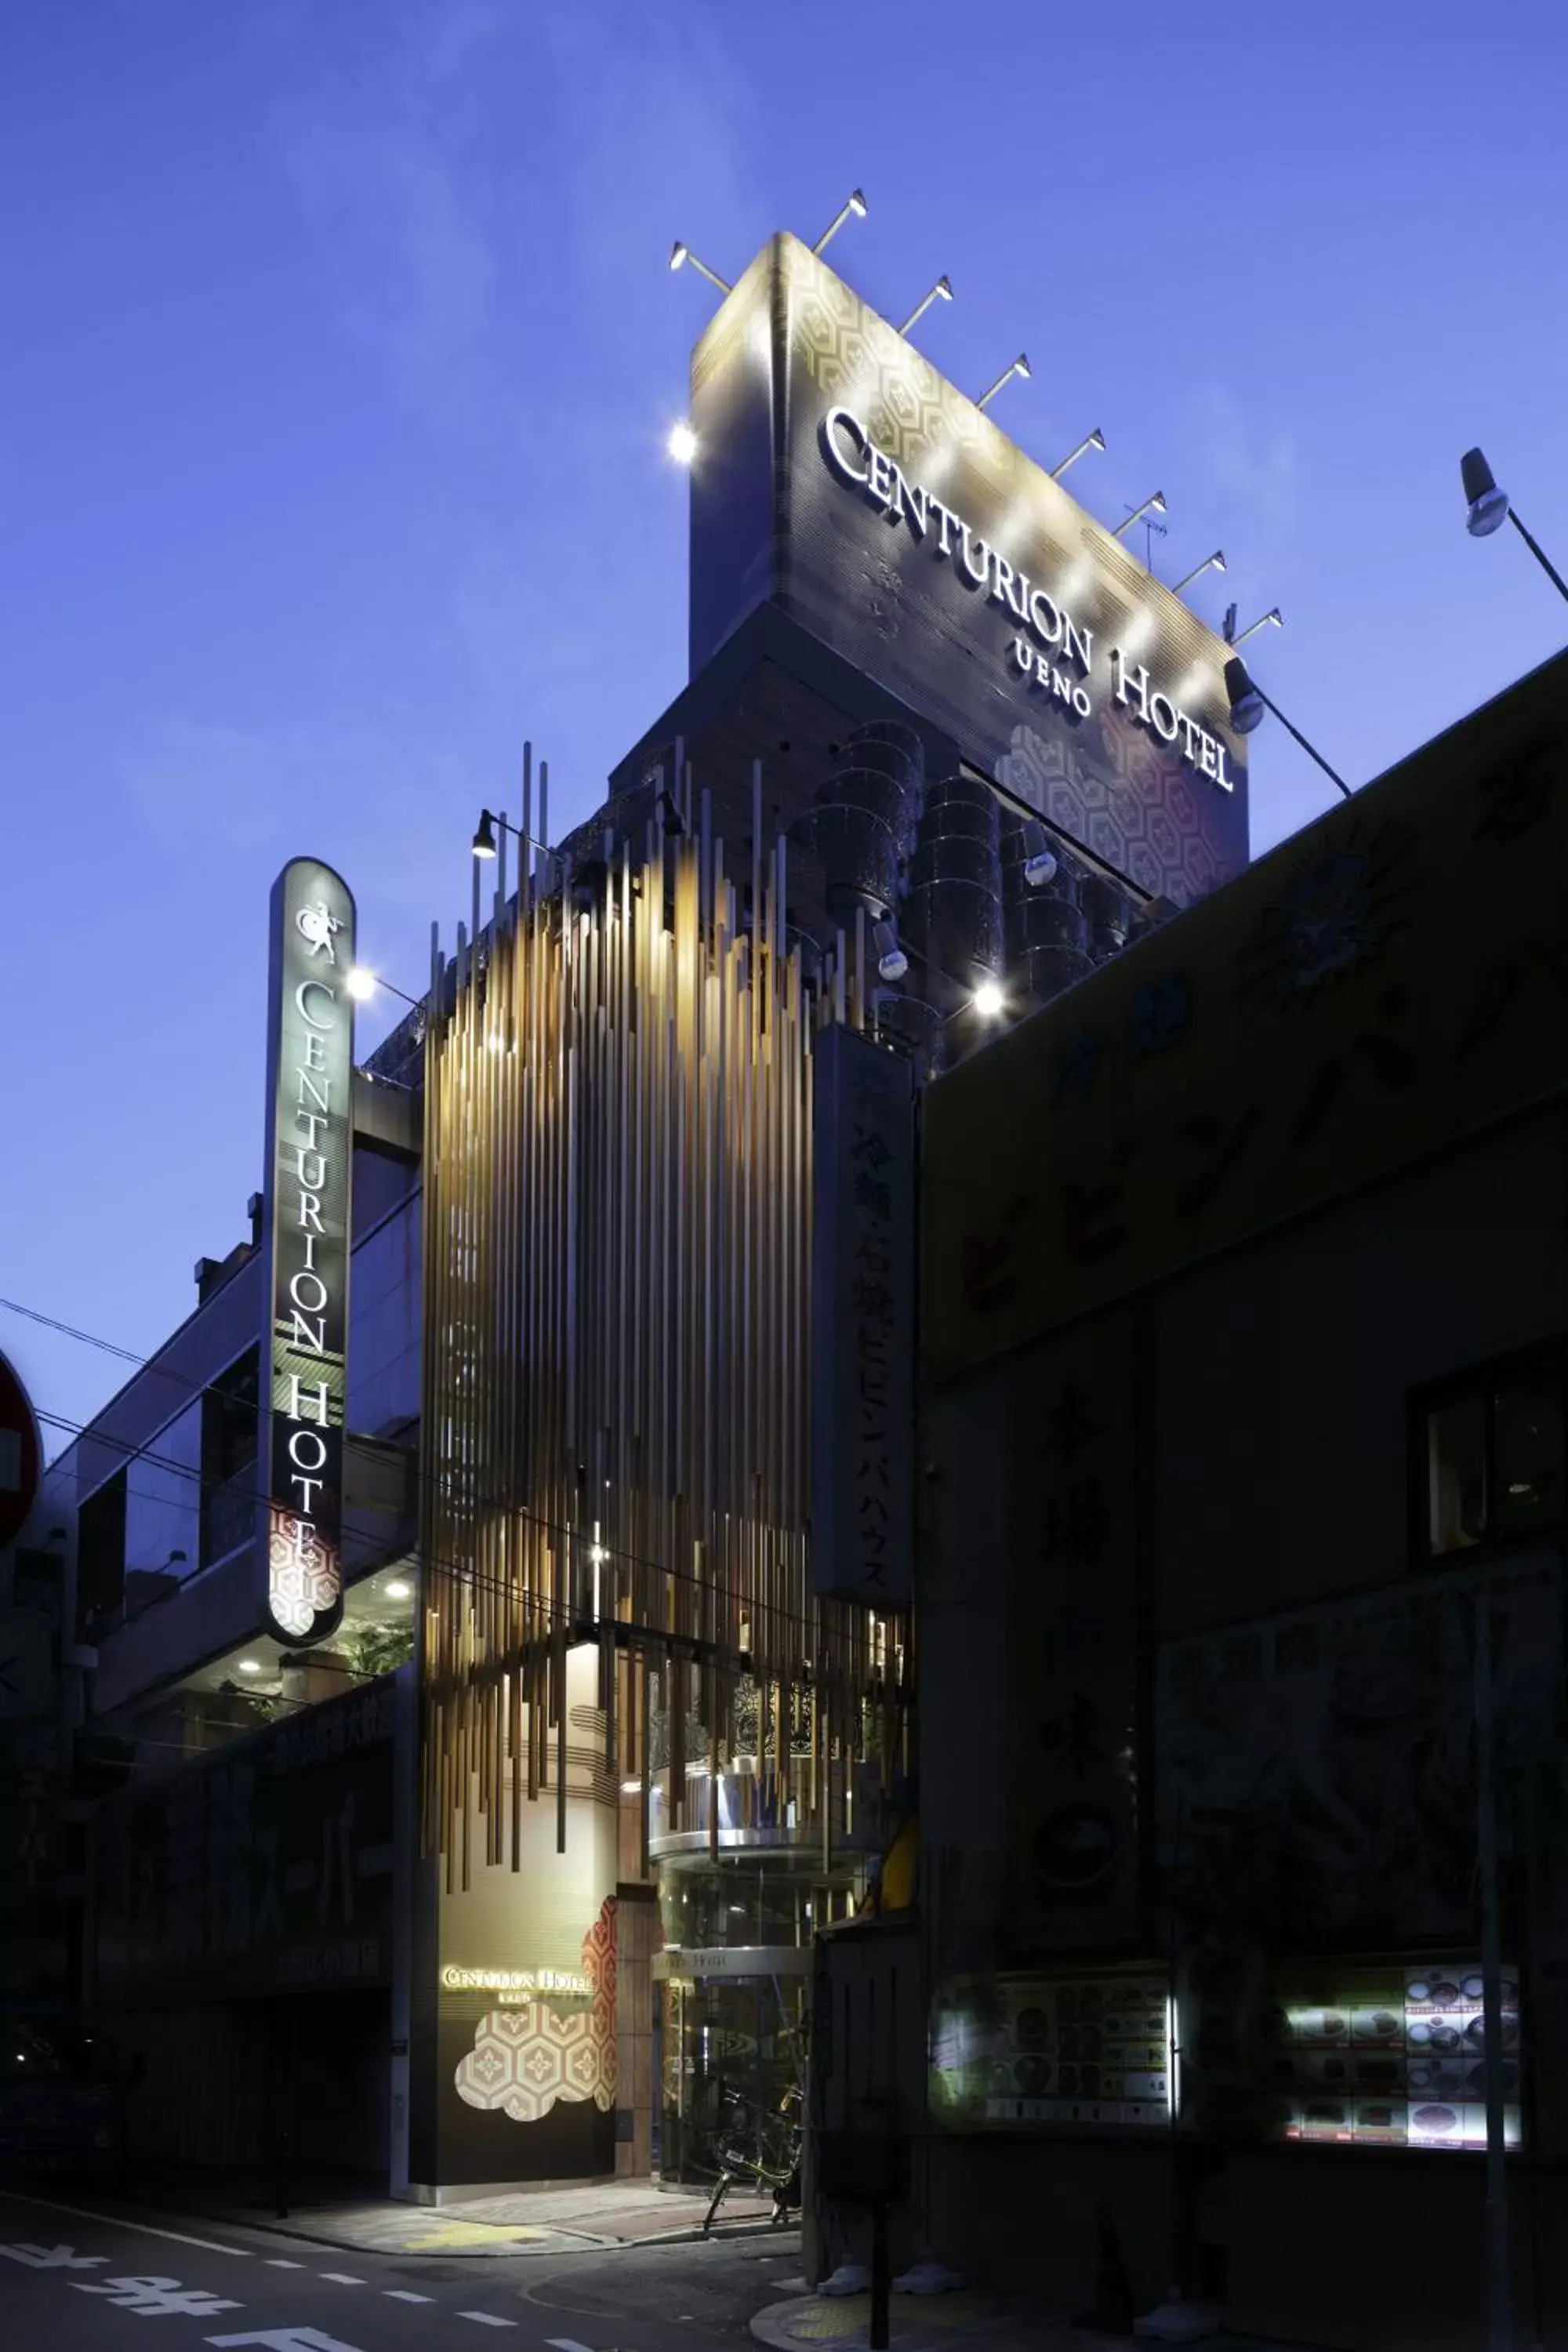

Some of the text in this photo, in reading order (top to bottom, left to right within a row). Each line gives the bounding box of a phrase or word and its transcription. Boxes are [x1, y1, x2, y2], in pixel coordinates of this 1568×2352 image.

[823, 405, 1234, 793] CENTURION HOTEL
[1013, 638, 1091, 719] UENO
[289, 979, 336, 1355] CENTURION
